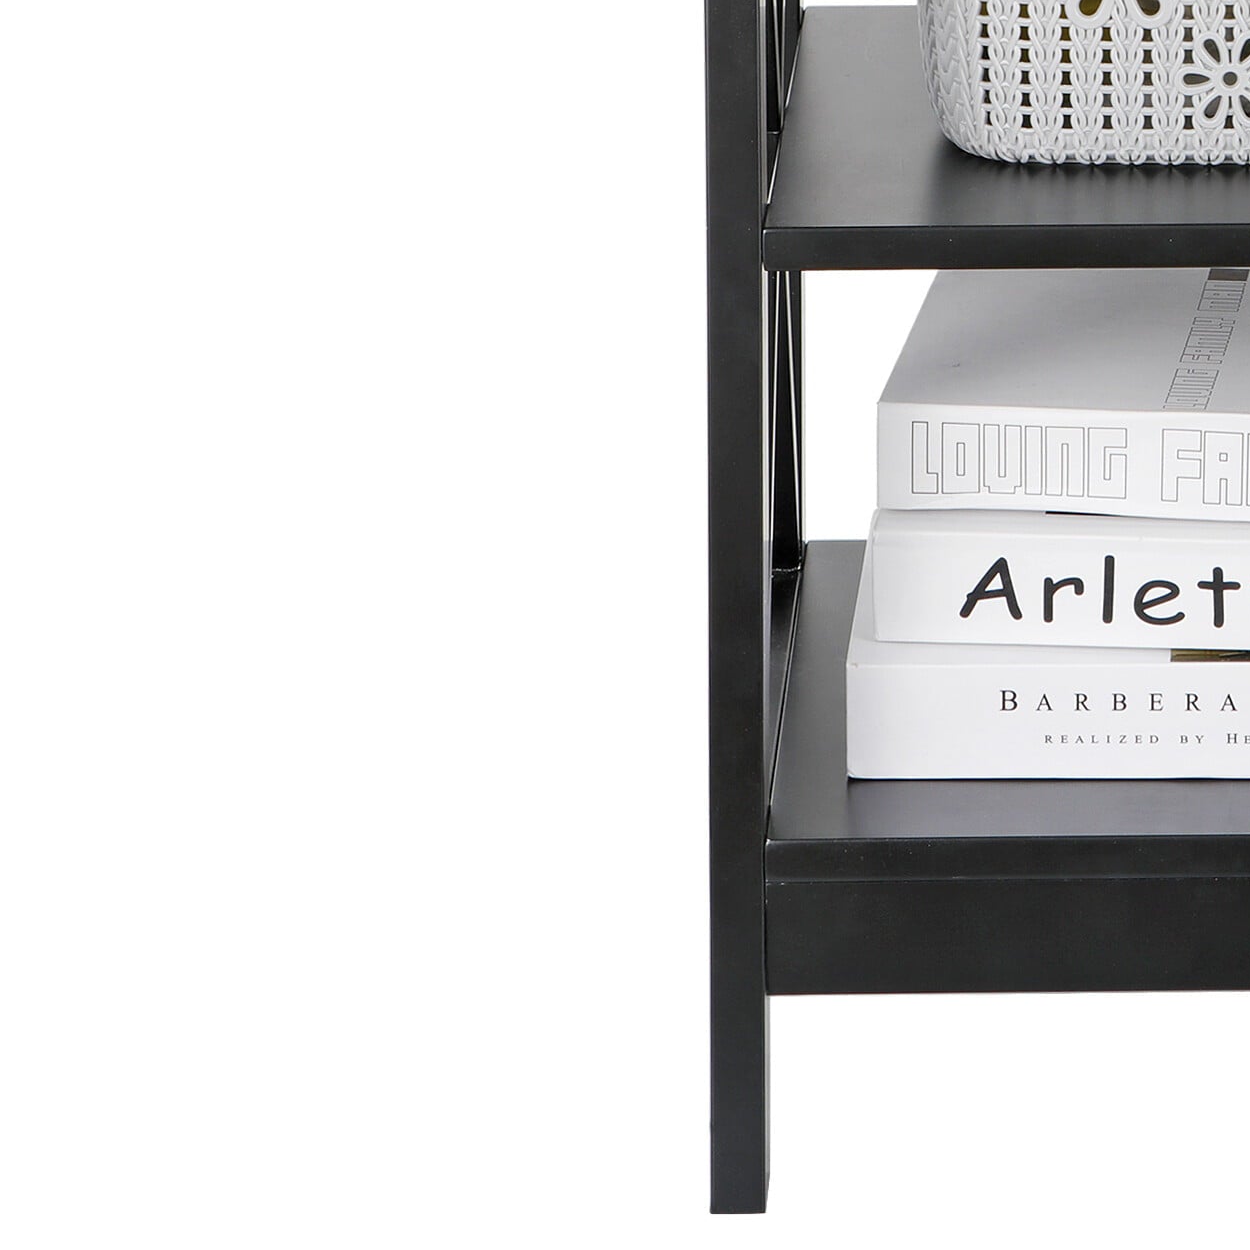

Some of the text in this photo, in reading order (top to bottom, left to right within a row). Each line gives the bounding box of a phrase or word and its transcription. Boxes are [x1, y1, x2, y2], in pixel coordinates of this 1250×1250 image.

[1198, 281, 1246, 312] MAN
[1180, 317, 1236, 364] FAMILY
[911, 421, 1127, 499] LOVING
[999, 689, 1238, 712] BARBERA
[1044, 734, 1160, 745] REALIZED
[1180, 734, 1205, 745] BY
